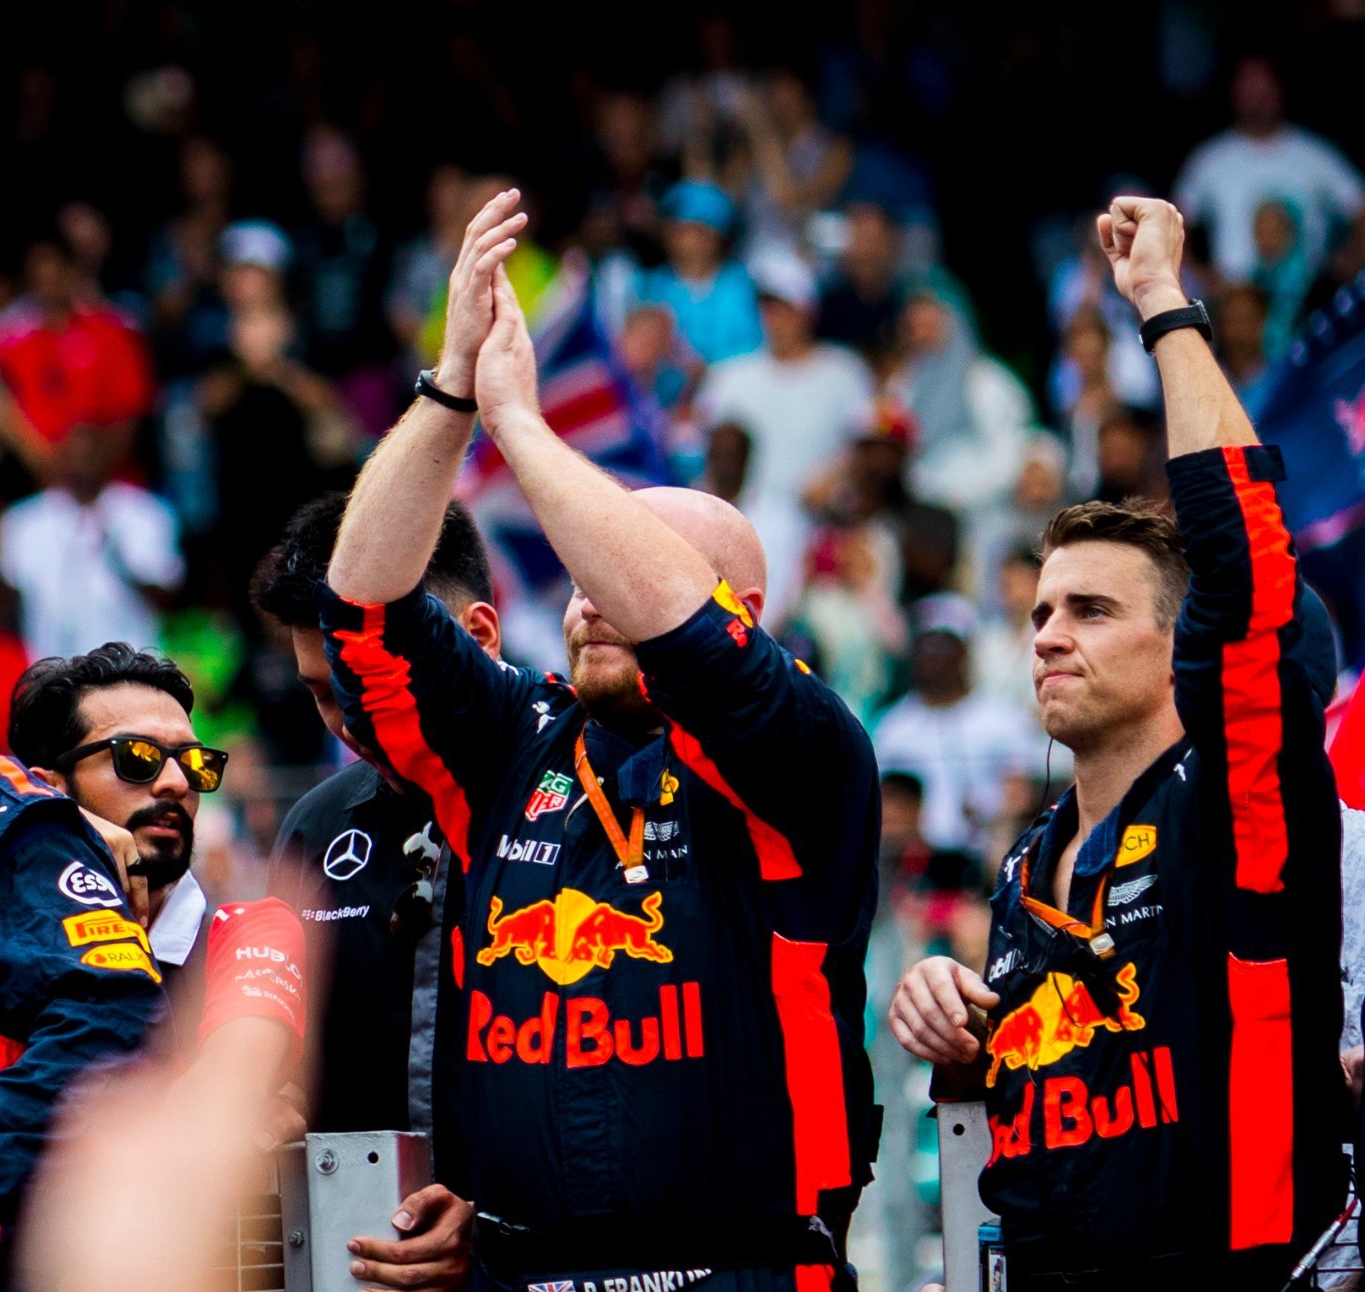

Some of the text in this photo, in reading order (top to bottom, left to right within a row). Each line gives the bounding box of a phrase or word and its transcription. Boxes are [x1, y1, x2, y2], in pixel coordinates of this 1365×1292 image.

[315, 904, 370, 922] BlackBerry
[467, 981, 705, 1069] Red Bull
[1043, 1046, 1179, 1150] Bull
